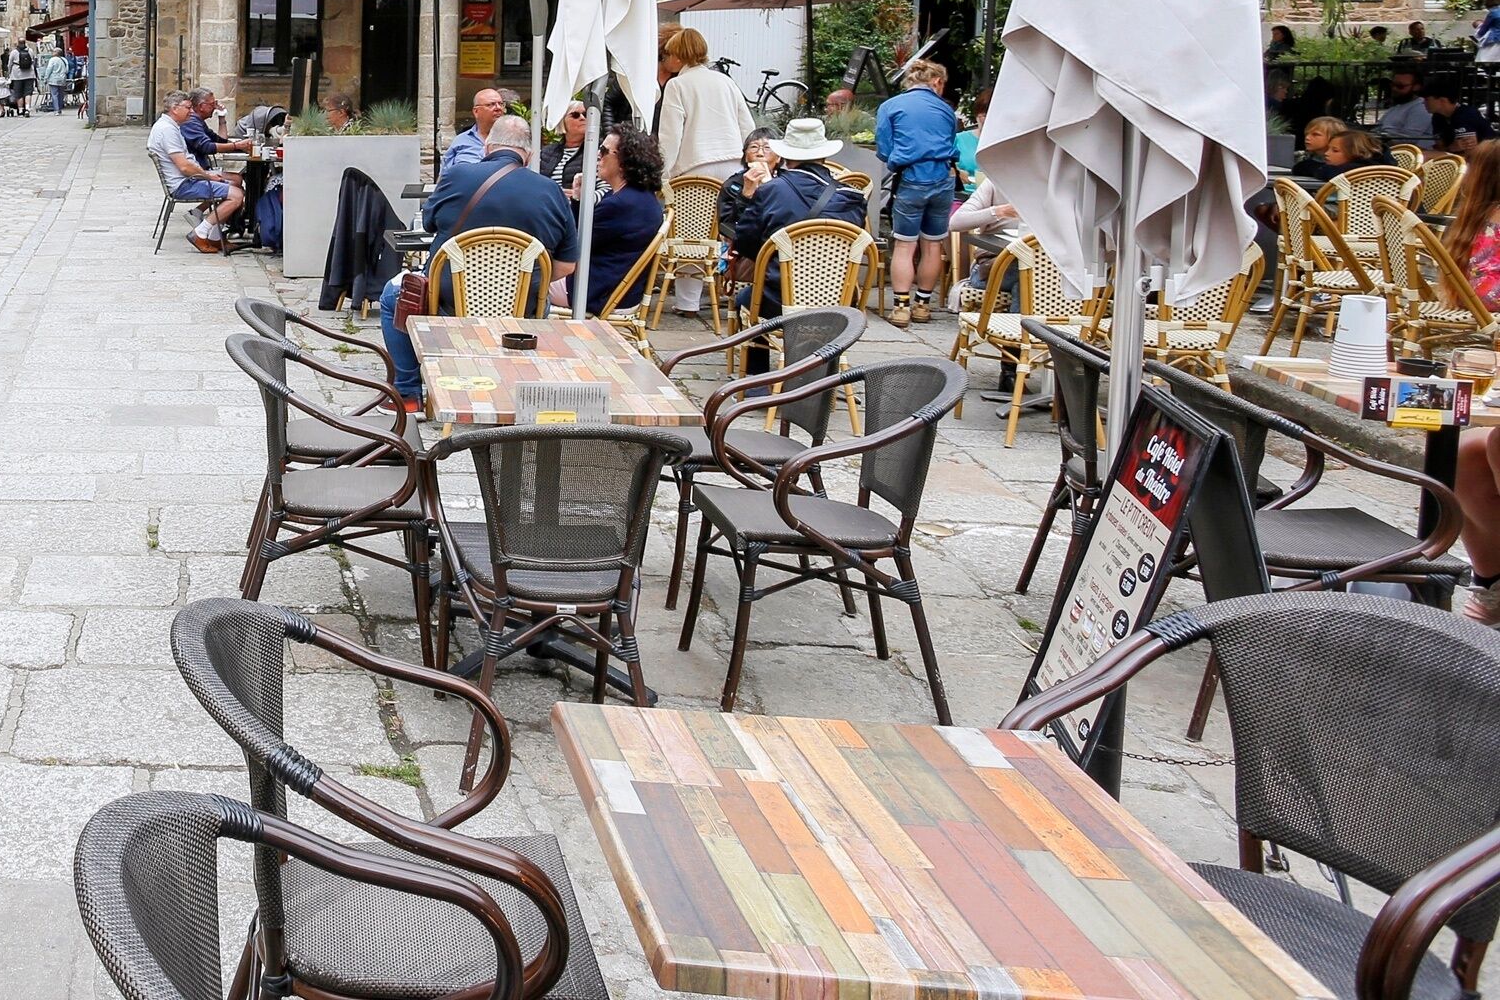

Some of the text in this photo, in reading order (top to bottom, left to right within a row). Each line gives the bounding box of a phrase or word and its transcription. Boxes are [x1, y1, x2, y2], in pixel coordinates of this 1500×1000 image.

[1146, 434, 1185, 476] Café Hôtel
[1135, 467, 1171, 504] du Théâtre
[1138, 513, 1158, 541] CREUX
